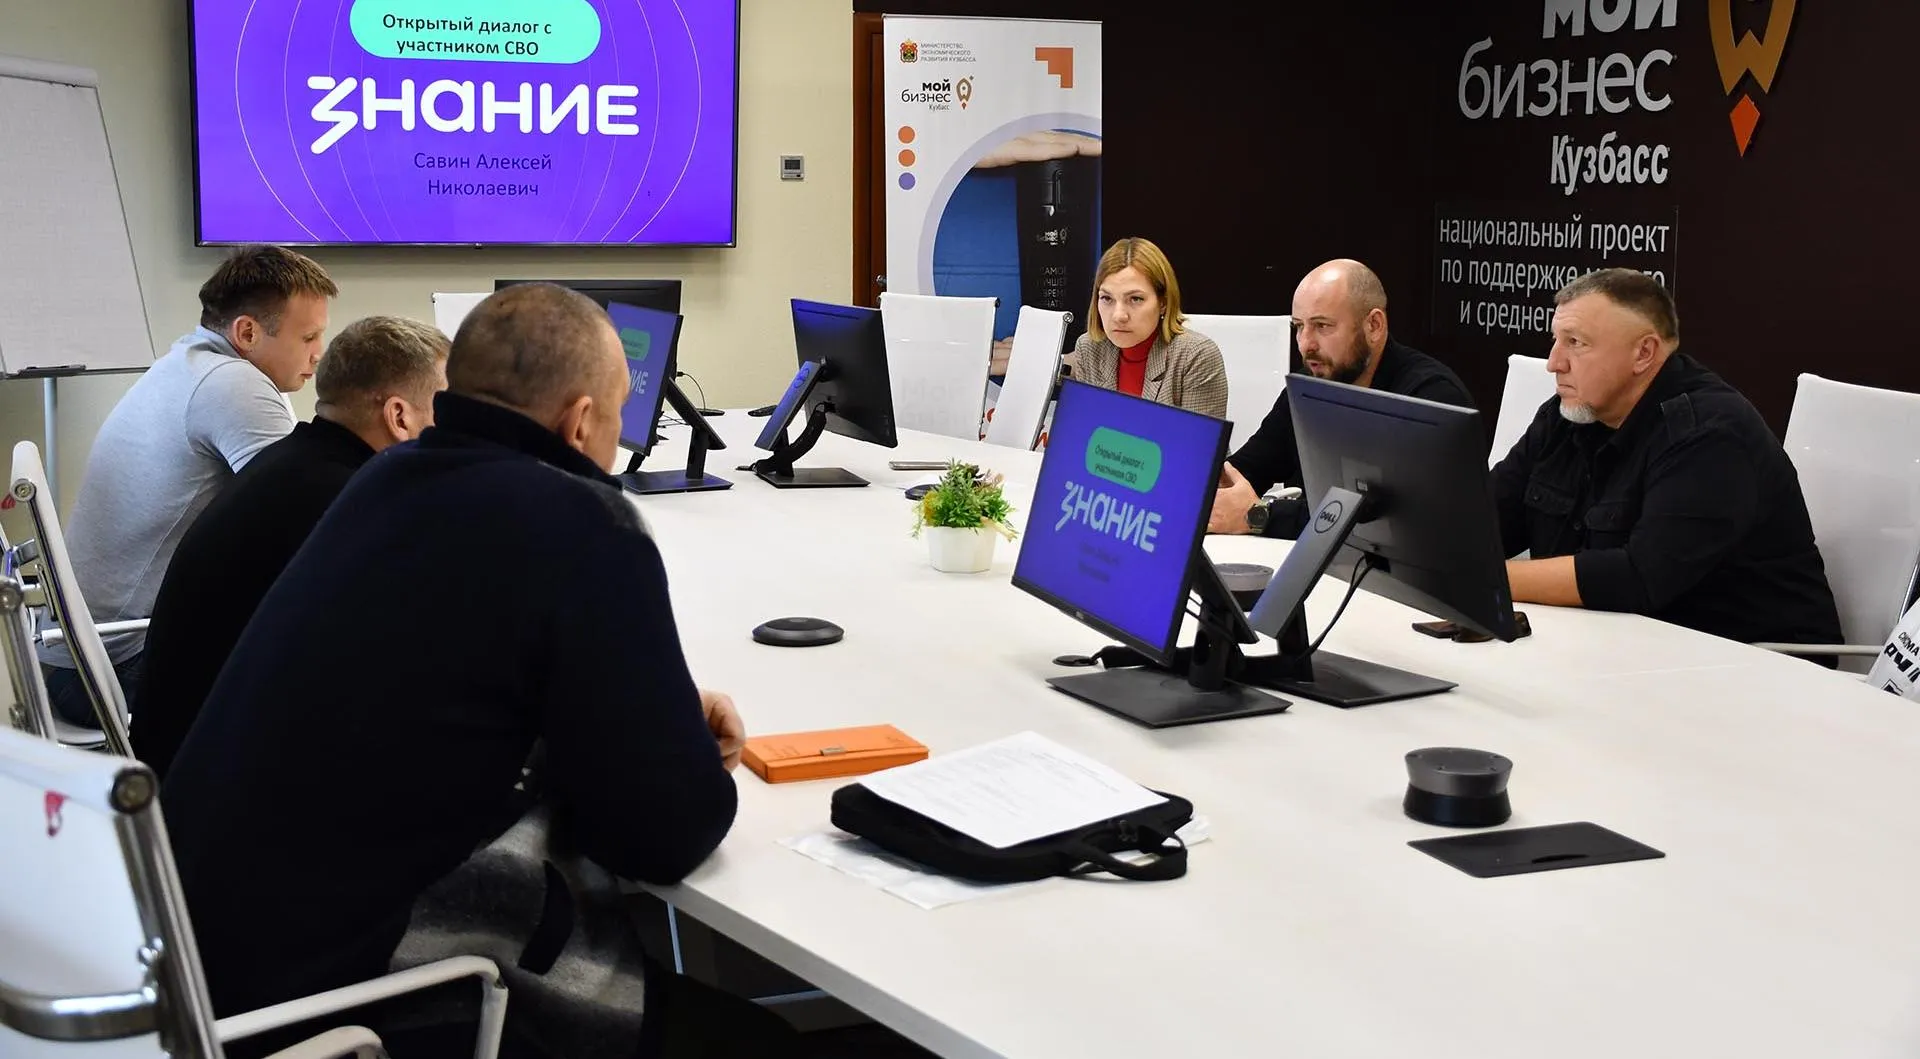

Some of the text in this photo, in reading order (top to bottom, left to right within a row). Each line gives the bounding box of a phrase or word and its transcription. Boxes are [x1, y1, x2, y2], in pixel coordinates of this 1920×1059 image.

[383, 14, 552, 34] Открытый диалог с
[397, 40, 539, 55] участником СВО
[922, 79, 951, 91] мой
[1458, 36, 1674, 119] бизнес
[901, 89, 951, 102] бизнес
[414, 152, 552, 169] Савин Алексей
[1550, 131, 1669, 196] Кузбасс
[428, 179, 539, 195] Николаевич
[1439, 213, 1670, 259] национальный проект
[1441, 258, 1462, 284] по
[1468, 259, 1578, 297] поддержке
[1459, 300, 1555, 335] и среднег
